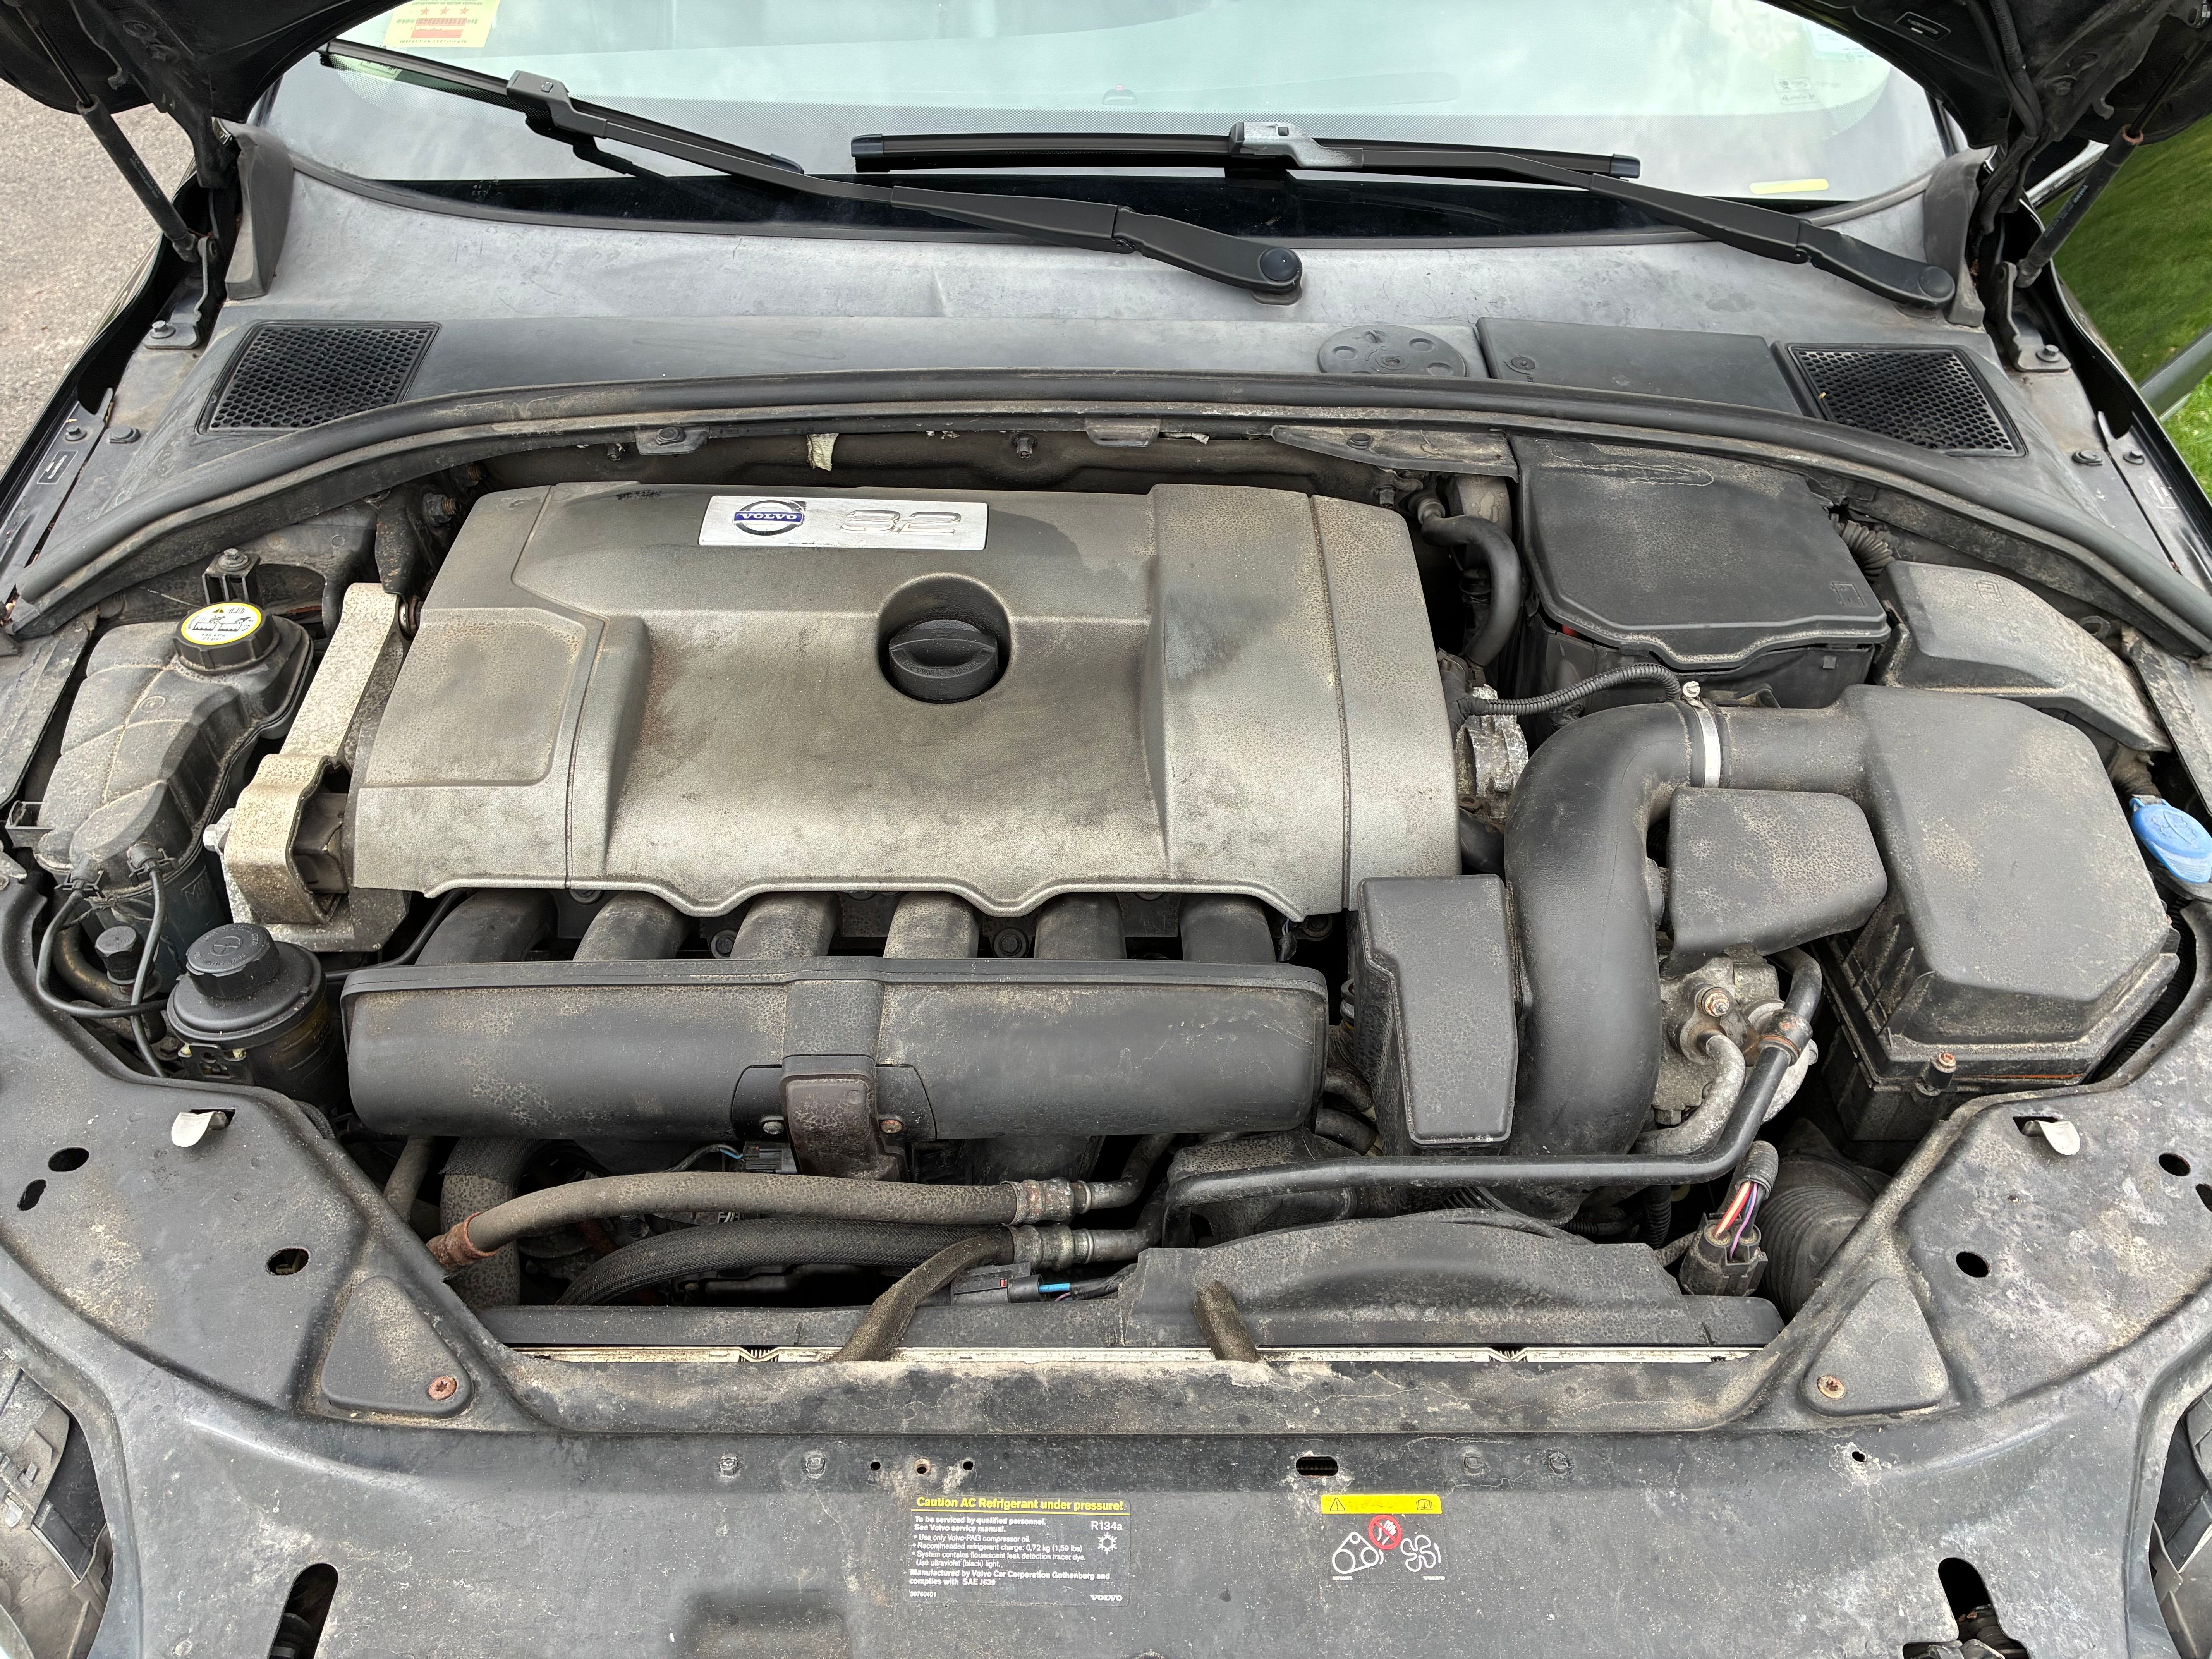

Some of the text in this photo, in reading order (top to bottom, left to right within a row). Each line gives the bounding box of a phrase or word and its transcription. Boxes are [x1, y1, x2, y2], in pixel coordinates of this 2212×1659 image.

[840, 510, 961, 536] 3.2
[917, 1497, 1123, 1512] Caution AC Refrigerant under pressure!
[967, 1516, 975, 1525] by
[977, 1517, 1007, 1525] qualified
[1091, 1520, 1123, 1531] R134a
[933, 1534, 946, 1542] only
[917, 1542, 965, 1550] Recommended
[967, 1543, 999, 1551] refrigerant
[1000, 1544, 1025, 1552] charge:
[1042, 1544, 1050, 1553] kg
[1052, 1544, 1069, 1553] (1,59
[1070, 1544, 1082, 1553] lbs)
[917, 1550, 940, 1559] System
[1072, 1554, 1086, 1562] dye.
[962, 1559, 984, 1567] (black)
[910, 1568, 960, 1577] Manufactured
[962, 1570, 970, 1578] by
[1007, 1570, 1051, 1579] Corporation
[1052, 1571, 1095, 1581] Gothenburg
[909, 1577, 942, 1586] complies
